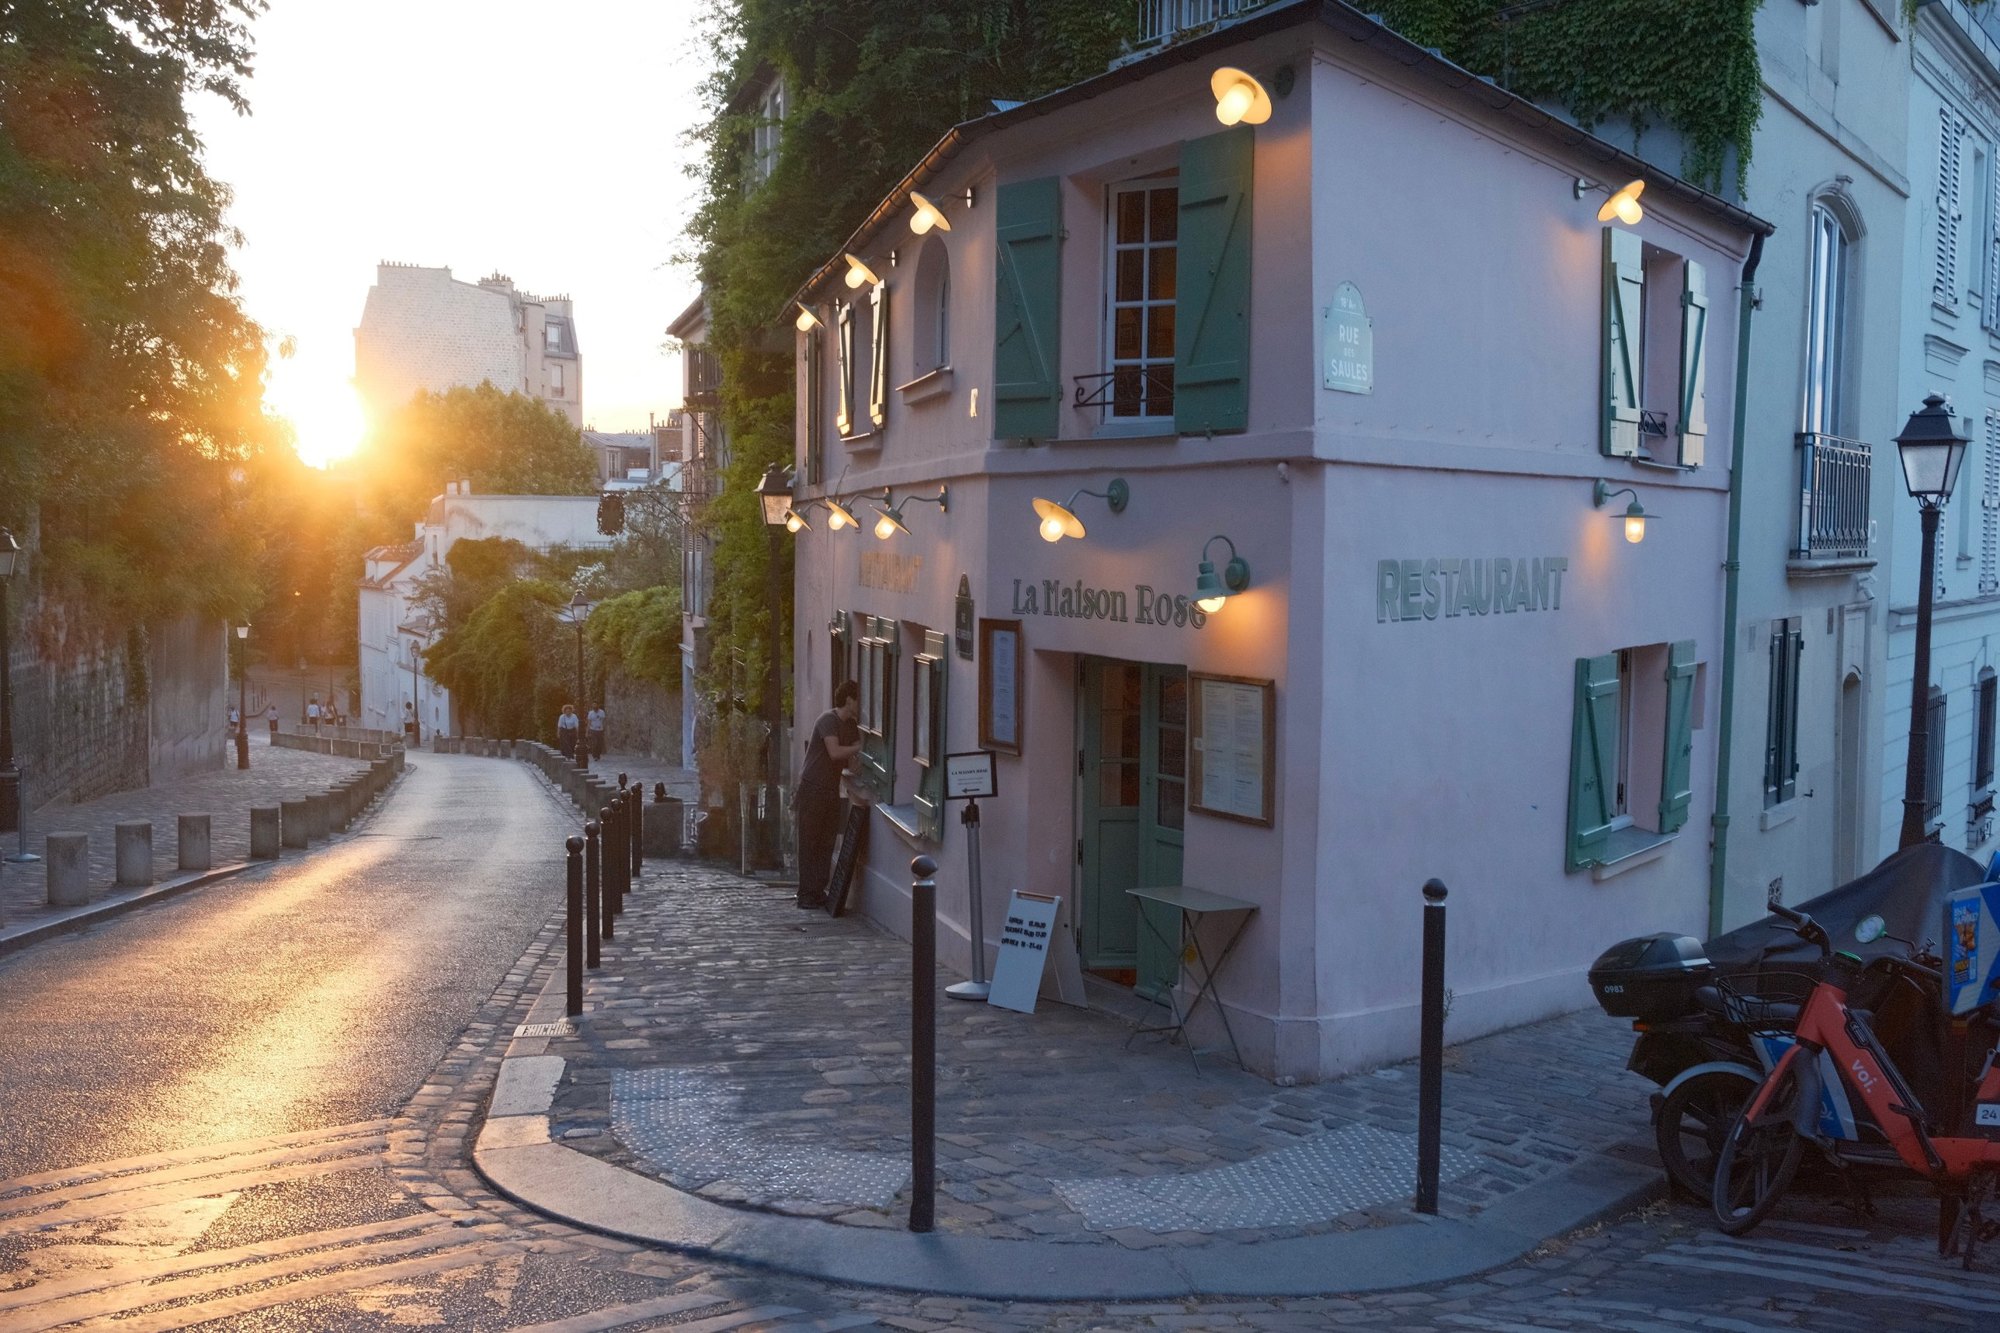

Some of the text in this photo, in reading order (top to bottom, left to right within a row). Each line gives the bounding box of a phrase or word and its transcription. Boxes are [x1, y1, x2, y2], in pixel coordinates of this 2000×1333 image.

[1339, 325, 1359, 345] RUE
[1331, 358, 1368, 381] SAULES
[1012, 579, 1039, 615] La
[1043, 579, 1129, 623] Maison
[1377, 557, 1569, 624] RESTAURANT
[1604, 985, 1624, 993] 0983
[1981, 1109, 1997, 1120] 24
